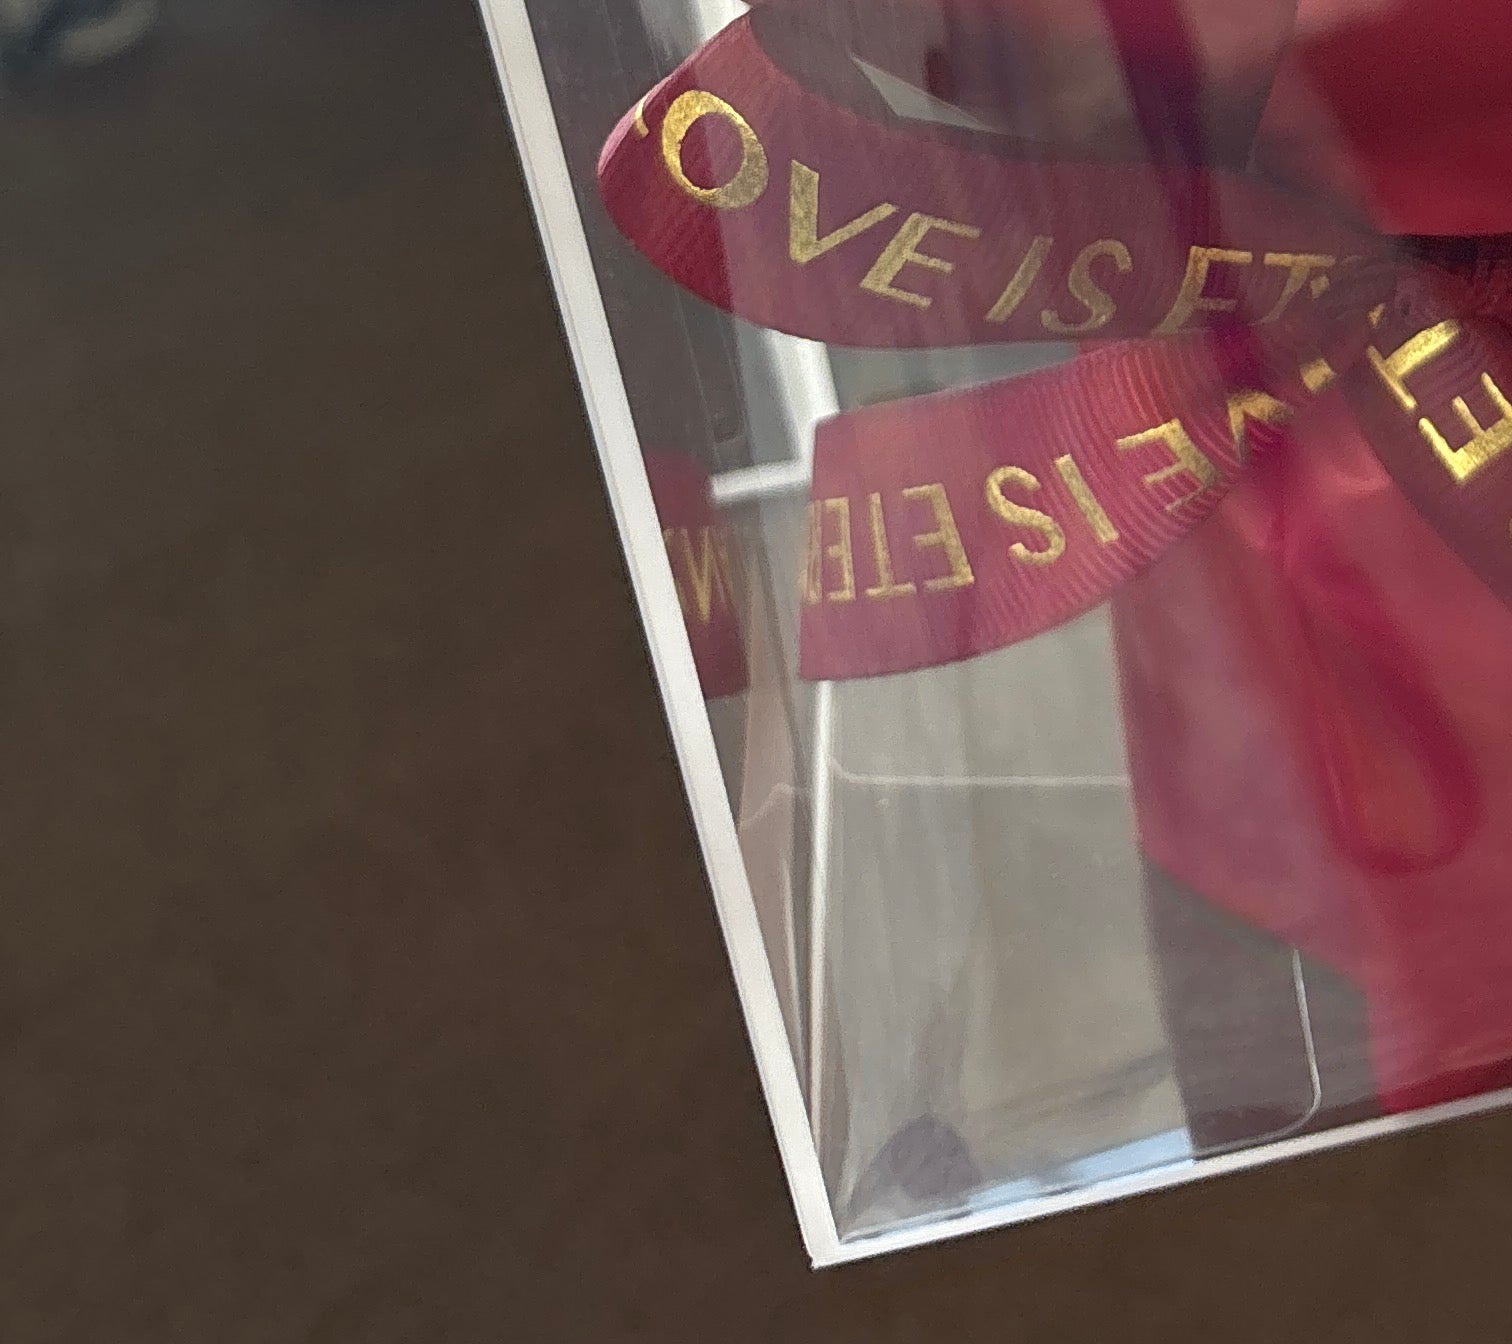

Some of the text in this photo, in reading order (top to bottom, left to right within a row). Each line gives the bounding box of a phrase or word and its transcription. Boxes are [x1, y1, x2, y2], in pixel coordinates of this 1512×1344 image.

[634, 88, 980, 310] OVE
[984, 234, 1135, 335] IS
[985, 452, 1121, 565] IS
